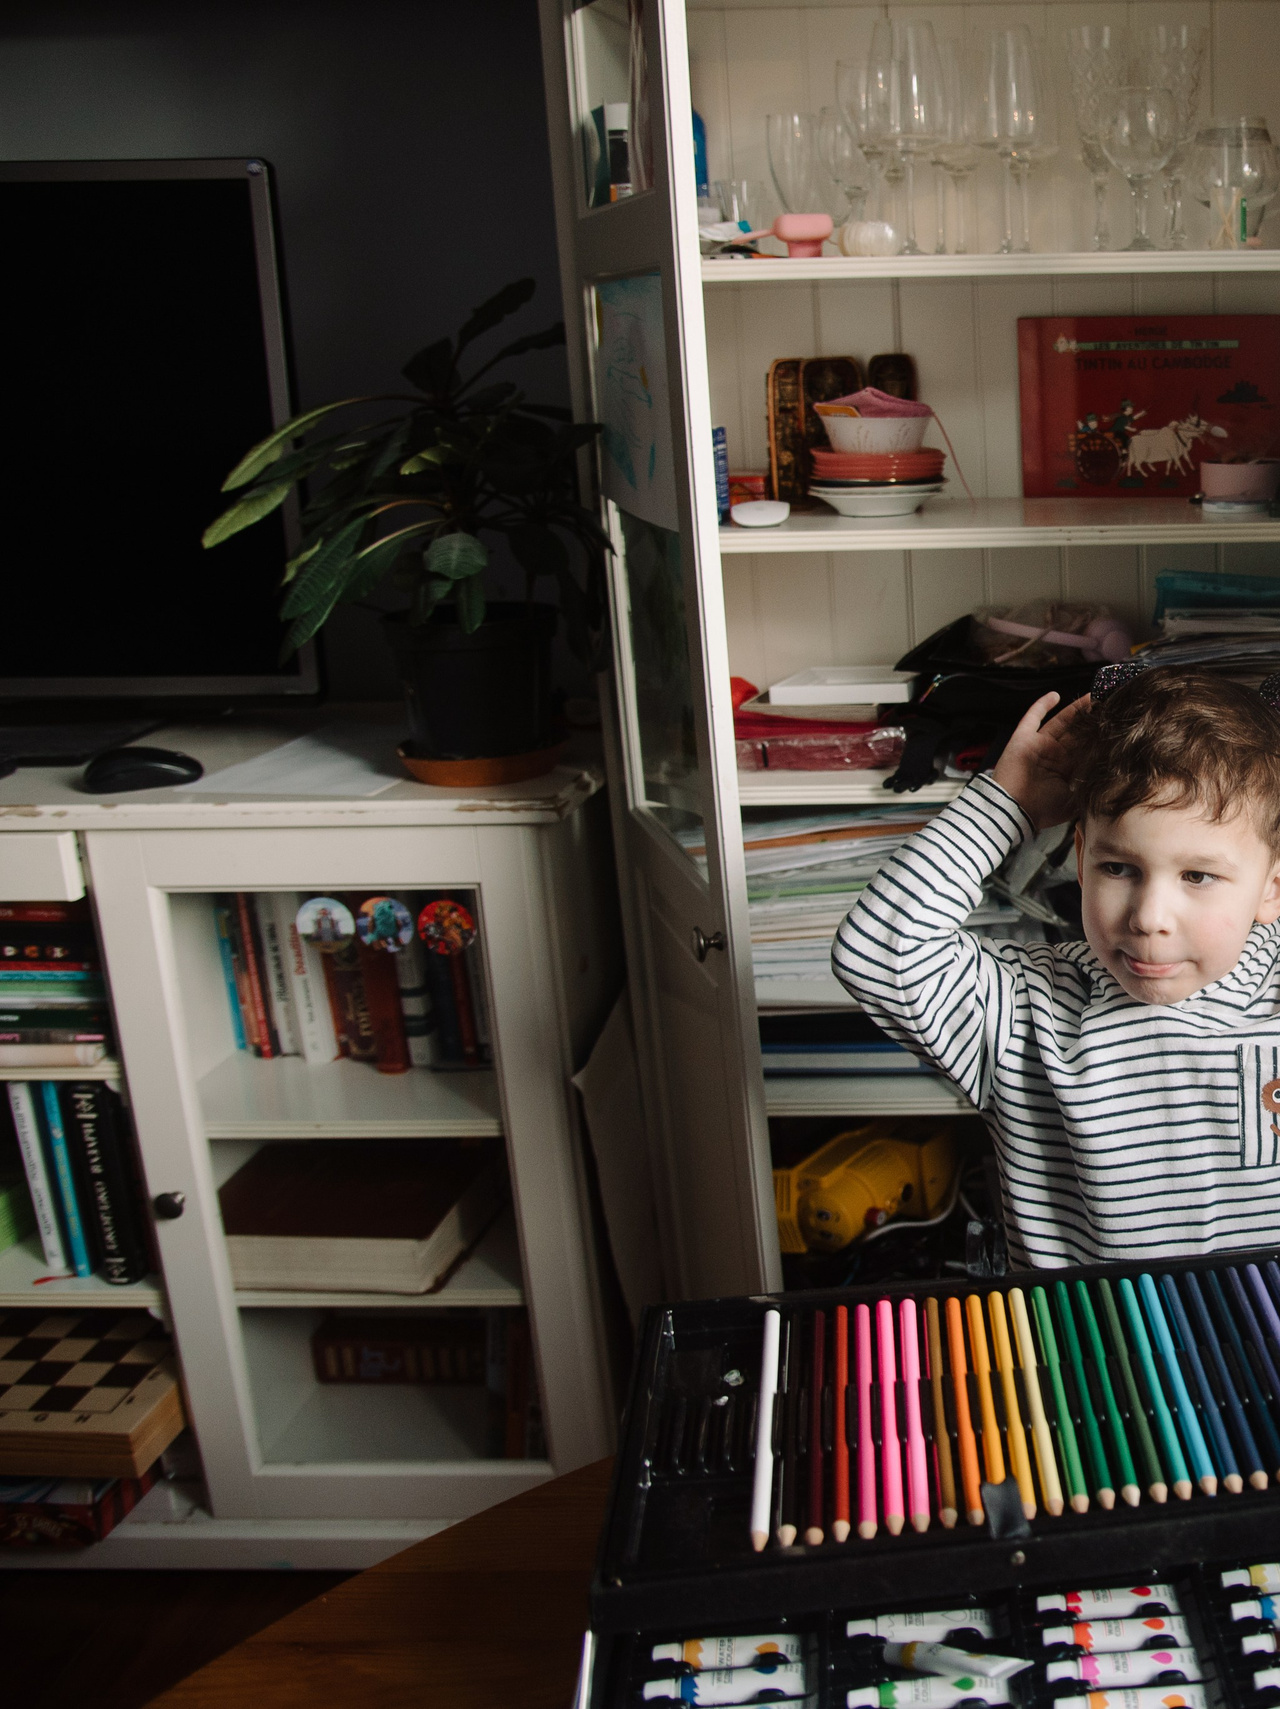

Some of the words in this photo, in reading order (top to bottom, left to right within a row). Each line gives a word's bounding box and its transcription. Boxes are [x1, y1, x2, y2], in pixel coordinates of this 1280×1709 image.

[1077, 357, 1123, 370] TINTIN
[1127, 357, 1147, 370] AU
[1152, 355, 1233, 370] CAMBODGE
